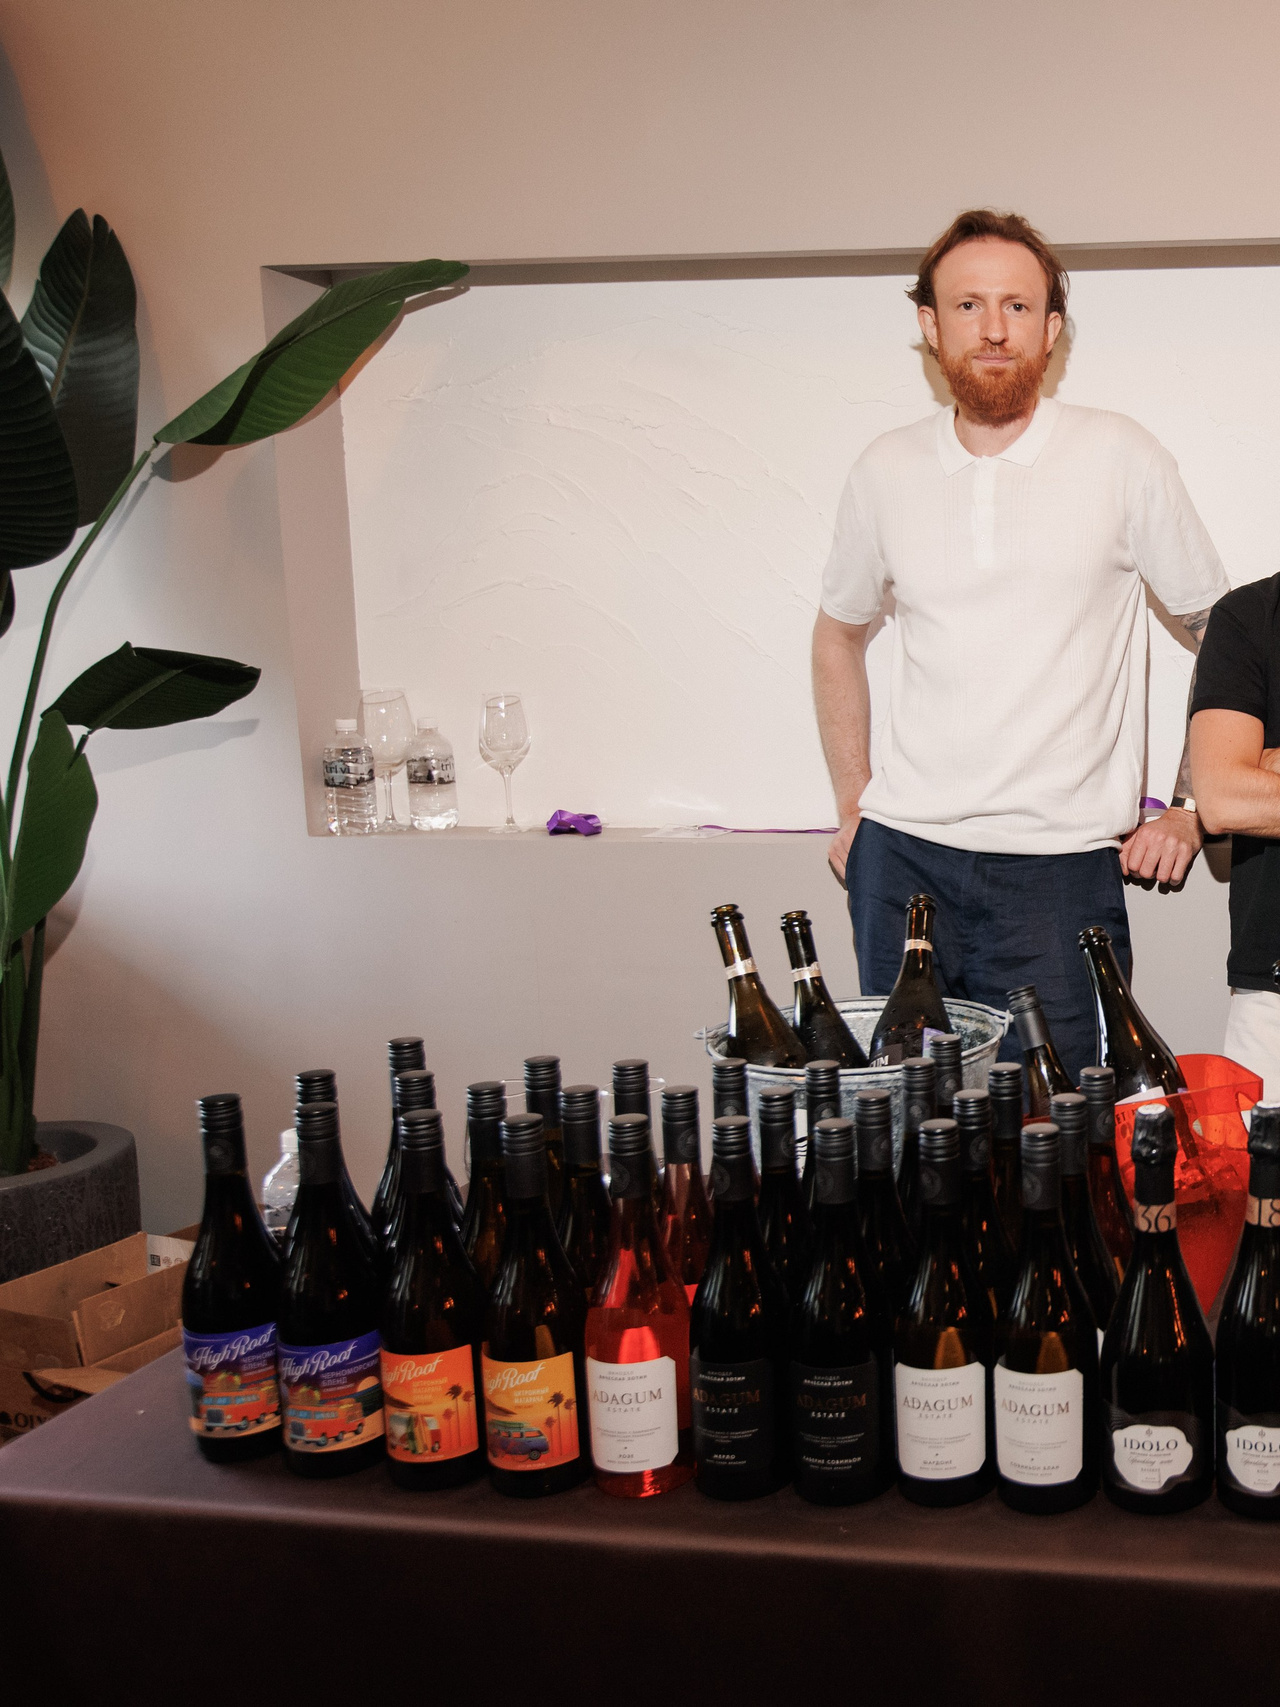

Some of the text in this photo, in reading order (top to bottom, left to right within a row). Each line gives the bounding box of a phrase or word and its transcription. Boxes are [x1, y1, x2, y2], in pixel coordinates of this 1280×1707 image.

[193, 1322, 277, 1371] High Roof
[281, 1340, 359, 1383] High Roof
[399, 1354, 444, 1384] Roof
[502, 1361, 547, 1391] Roof
[593, 1387, 663, 1406] ADAGUM
[693, 1387, 760, 1406] ADAGUM
[902, 1393, 973, 1412] ADAGUM
[706, 1406, 739, 1414] ESTATE
[1001, 1398, 1070, 1417] ADAGUM
[1123, 1437, 1178, 1452] IDOLO
